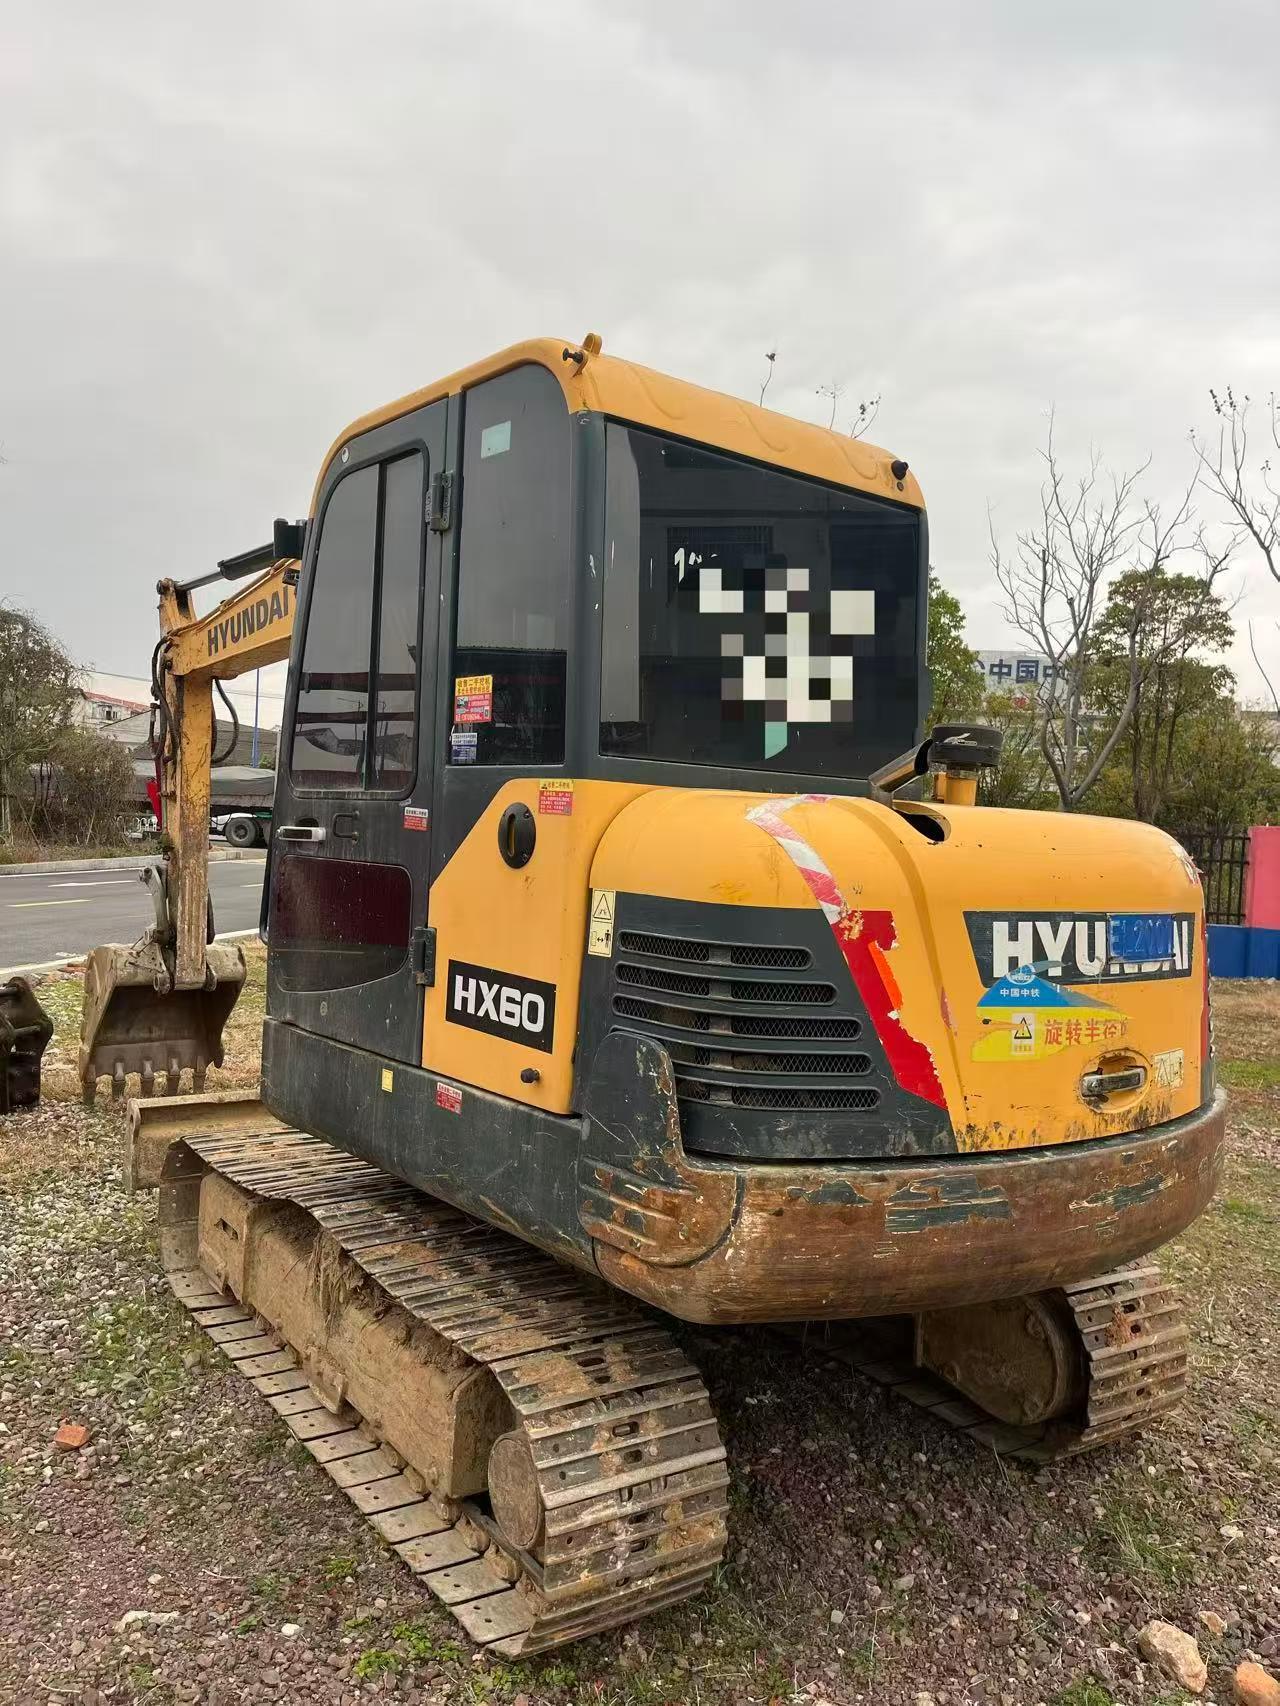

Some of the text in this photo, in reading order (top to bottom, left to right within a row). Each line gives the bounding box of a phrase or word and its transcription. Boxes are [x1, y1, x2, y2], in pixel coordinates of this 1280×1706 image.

[208, 586, 288, 656] HYUNDAI
[454, 975, 545, 1033] HX60
[1000, 987, 1040, 998] 中国中铁
